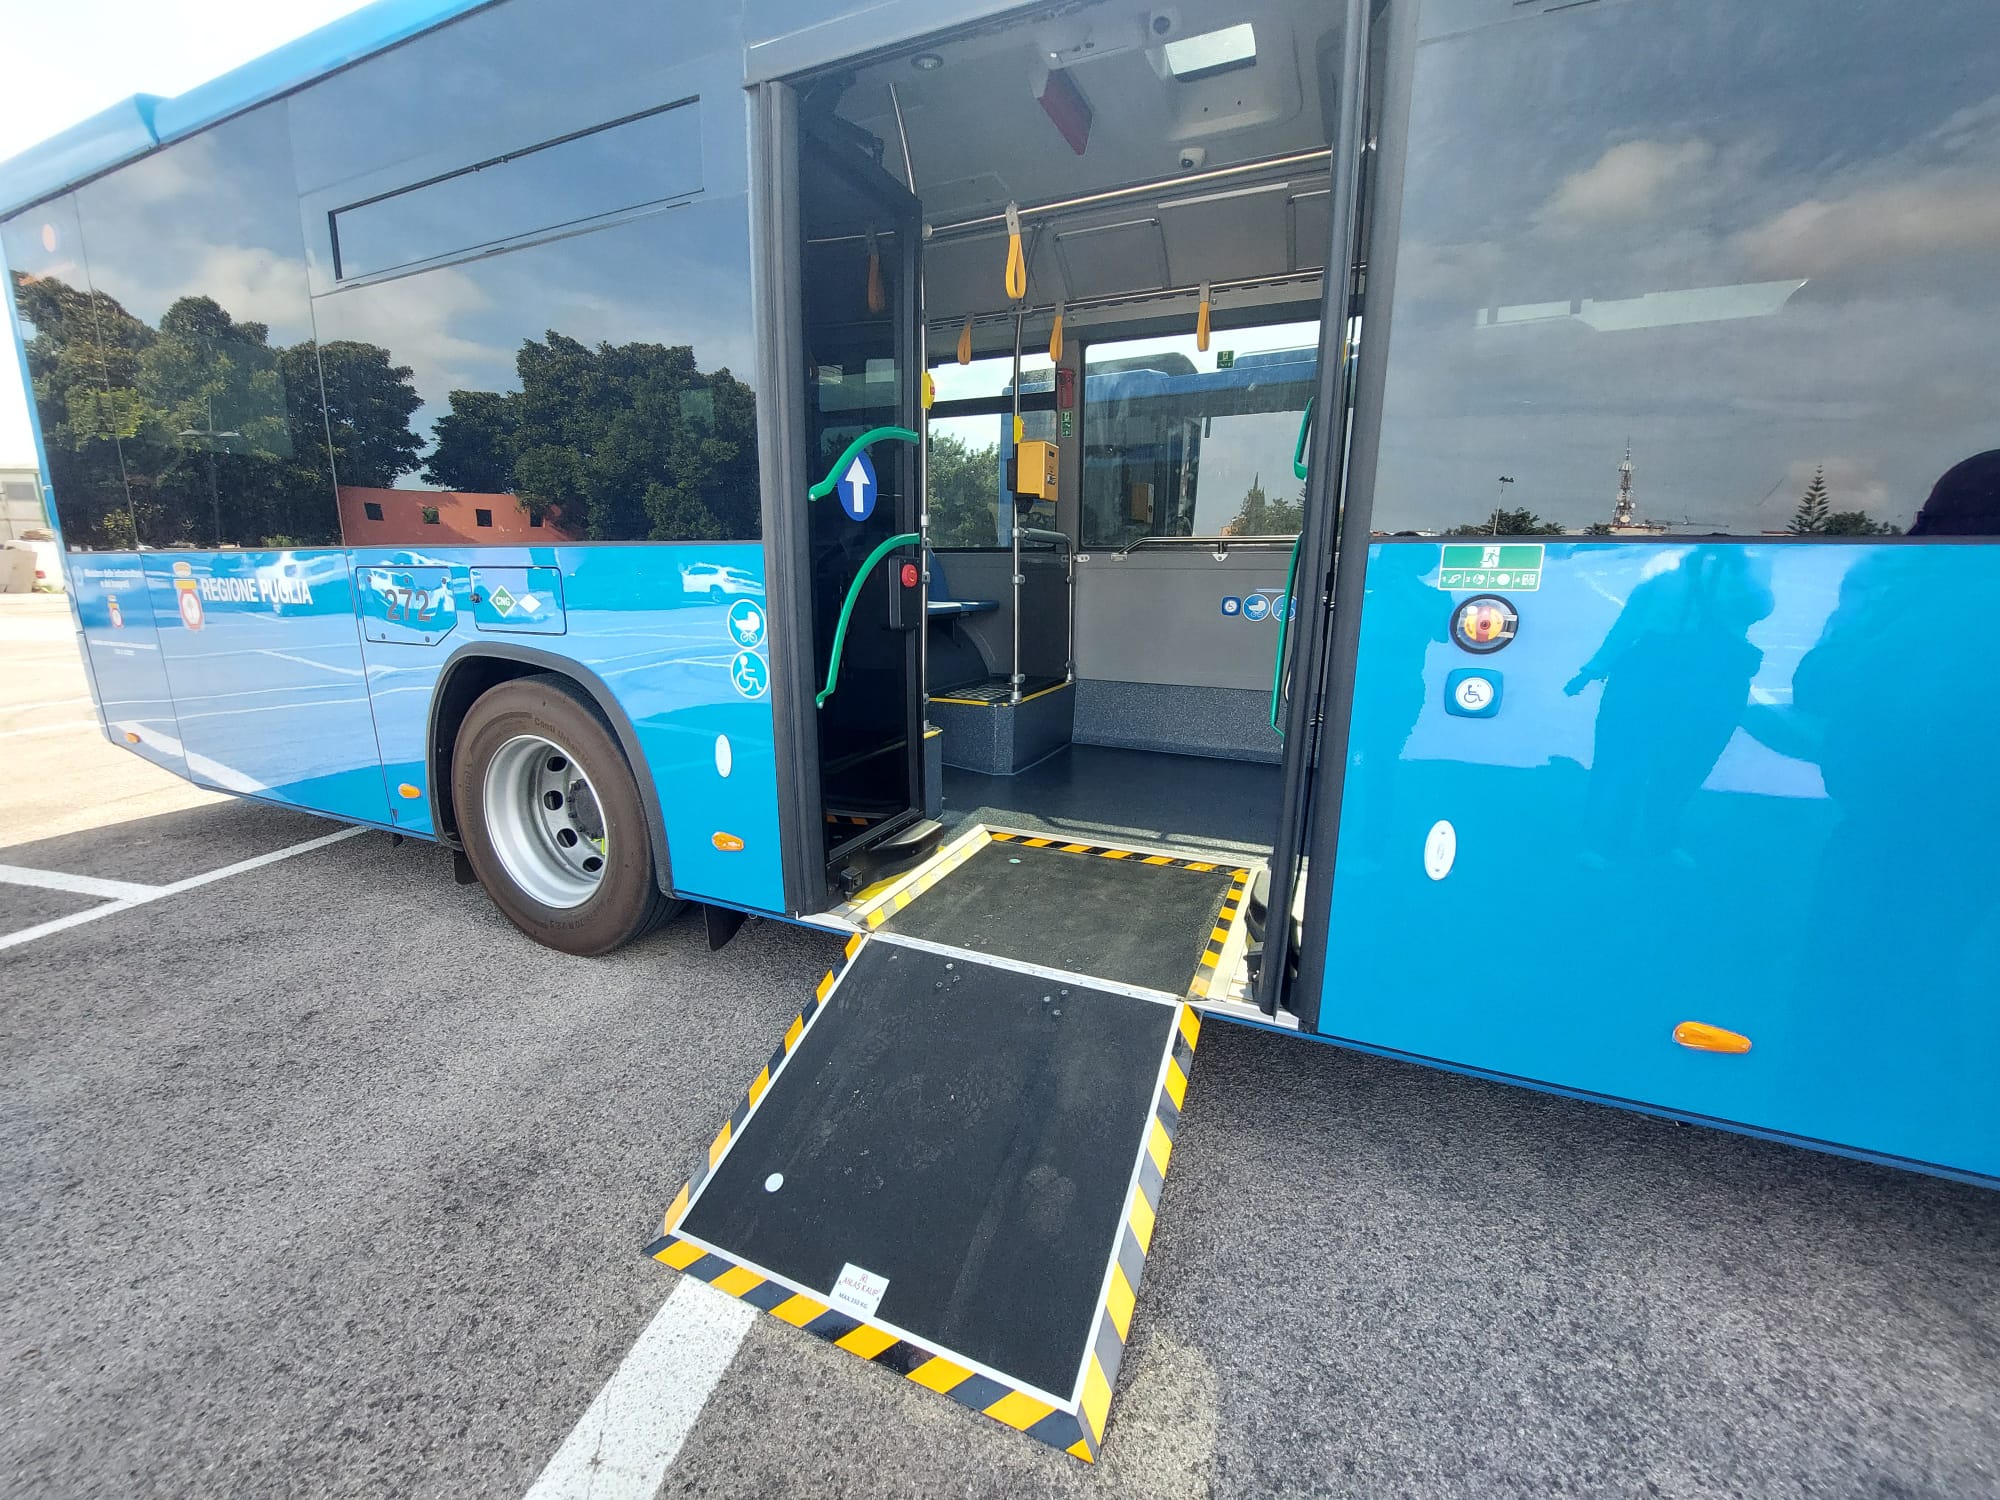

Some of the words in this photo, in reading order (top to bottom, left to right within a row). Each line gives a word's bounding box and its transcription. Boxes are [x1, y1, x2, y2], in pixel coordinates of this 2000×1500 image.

[201, 578, 259, 602] REGIONE
[260, 579, 313, 605] PUGLIA
[495, 596, 511, 607] CNG
[385, 589, 431, 622] 272
